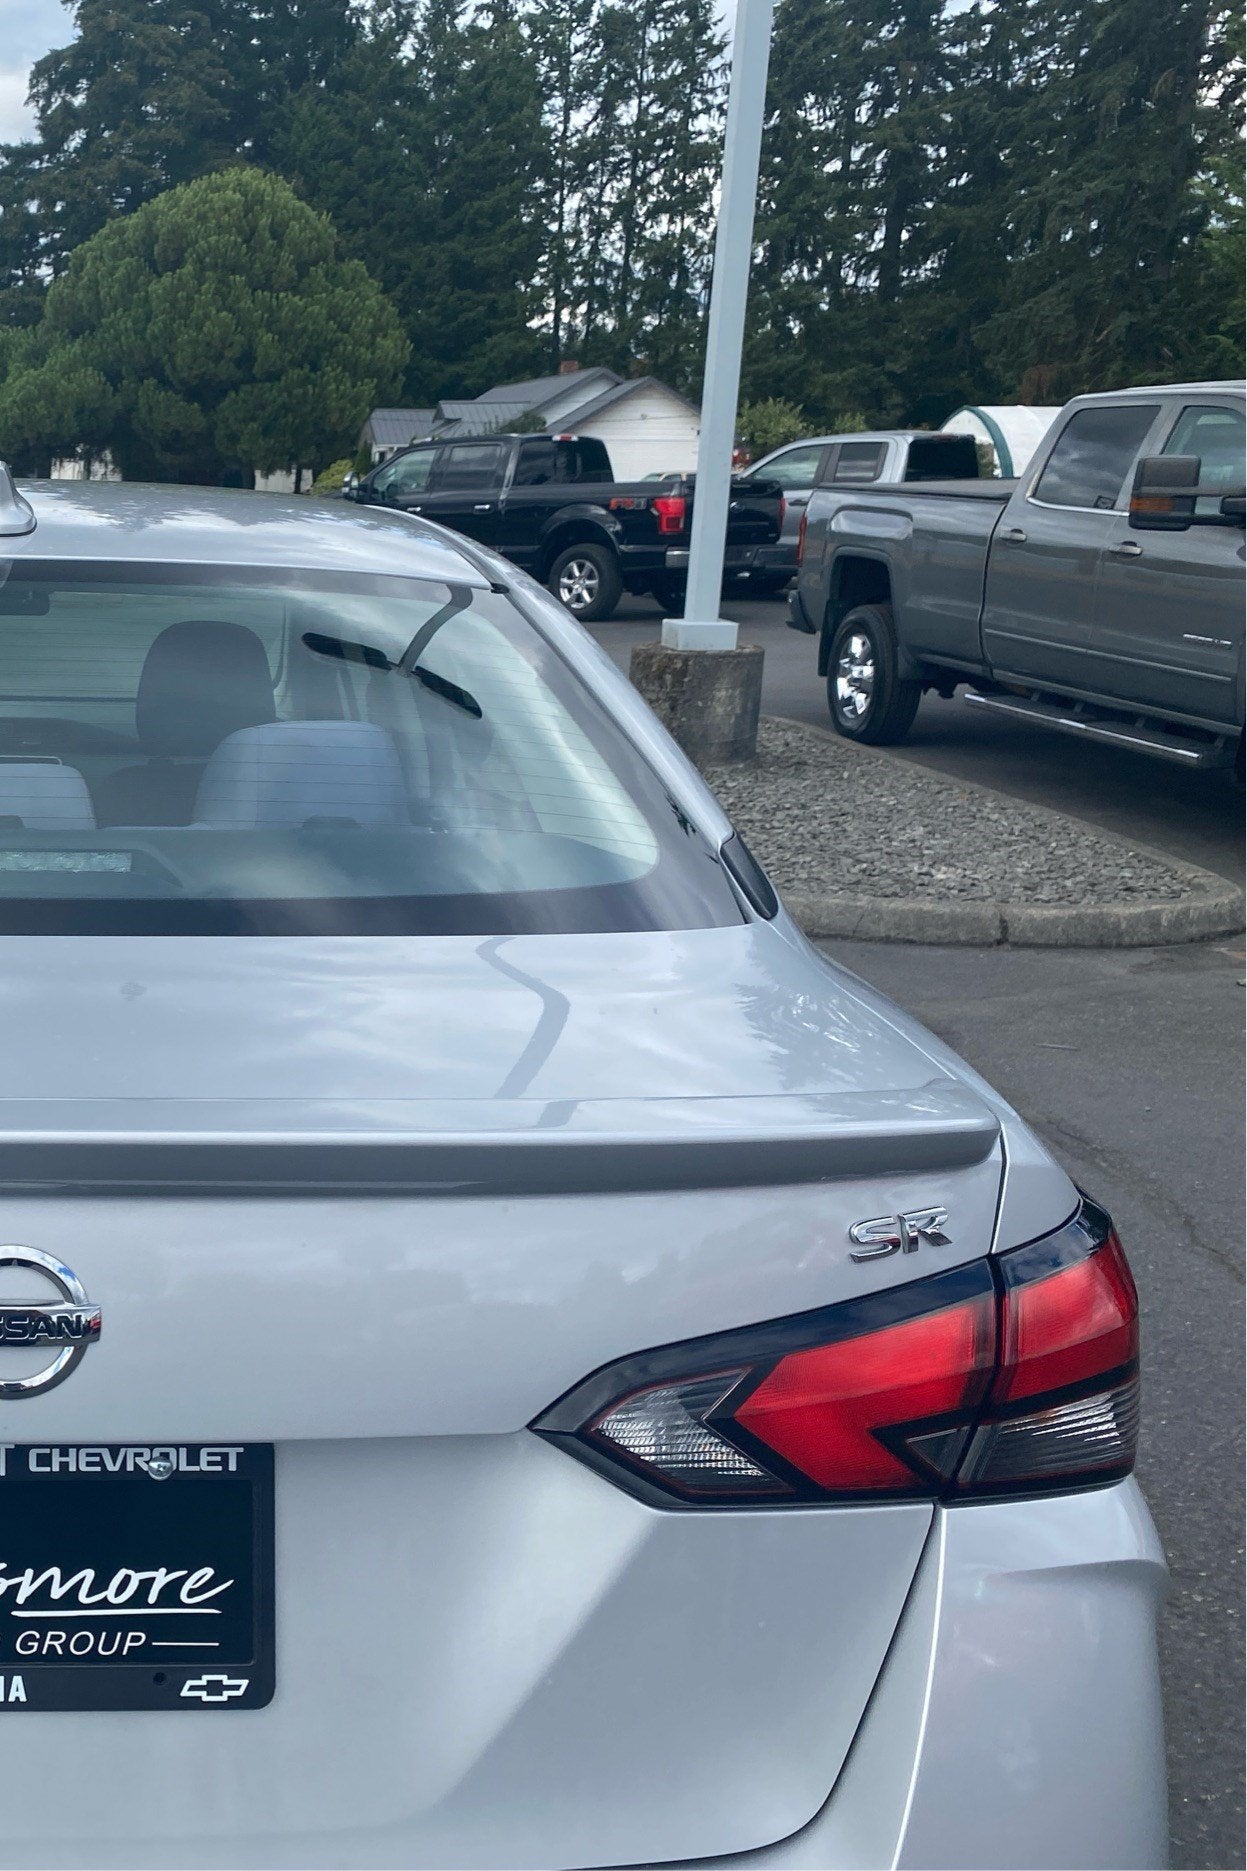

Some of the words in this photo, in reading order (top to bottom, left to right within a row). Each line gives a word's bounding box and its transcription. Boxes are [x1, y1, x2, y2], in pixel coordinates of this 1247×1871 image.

[849, 1206, 952, 1263] SR
[28, 1447, 244, 1473] CHEVROLET
[15, 1630, 147, 1656] GROUP
